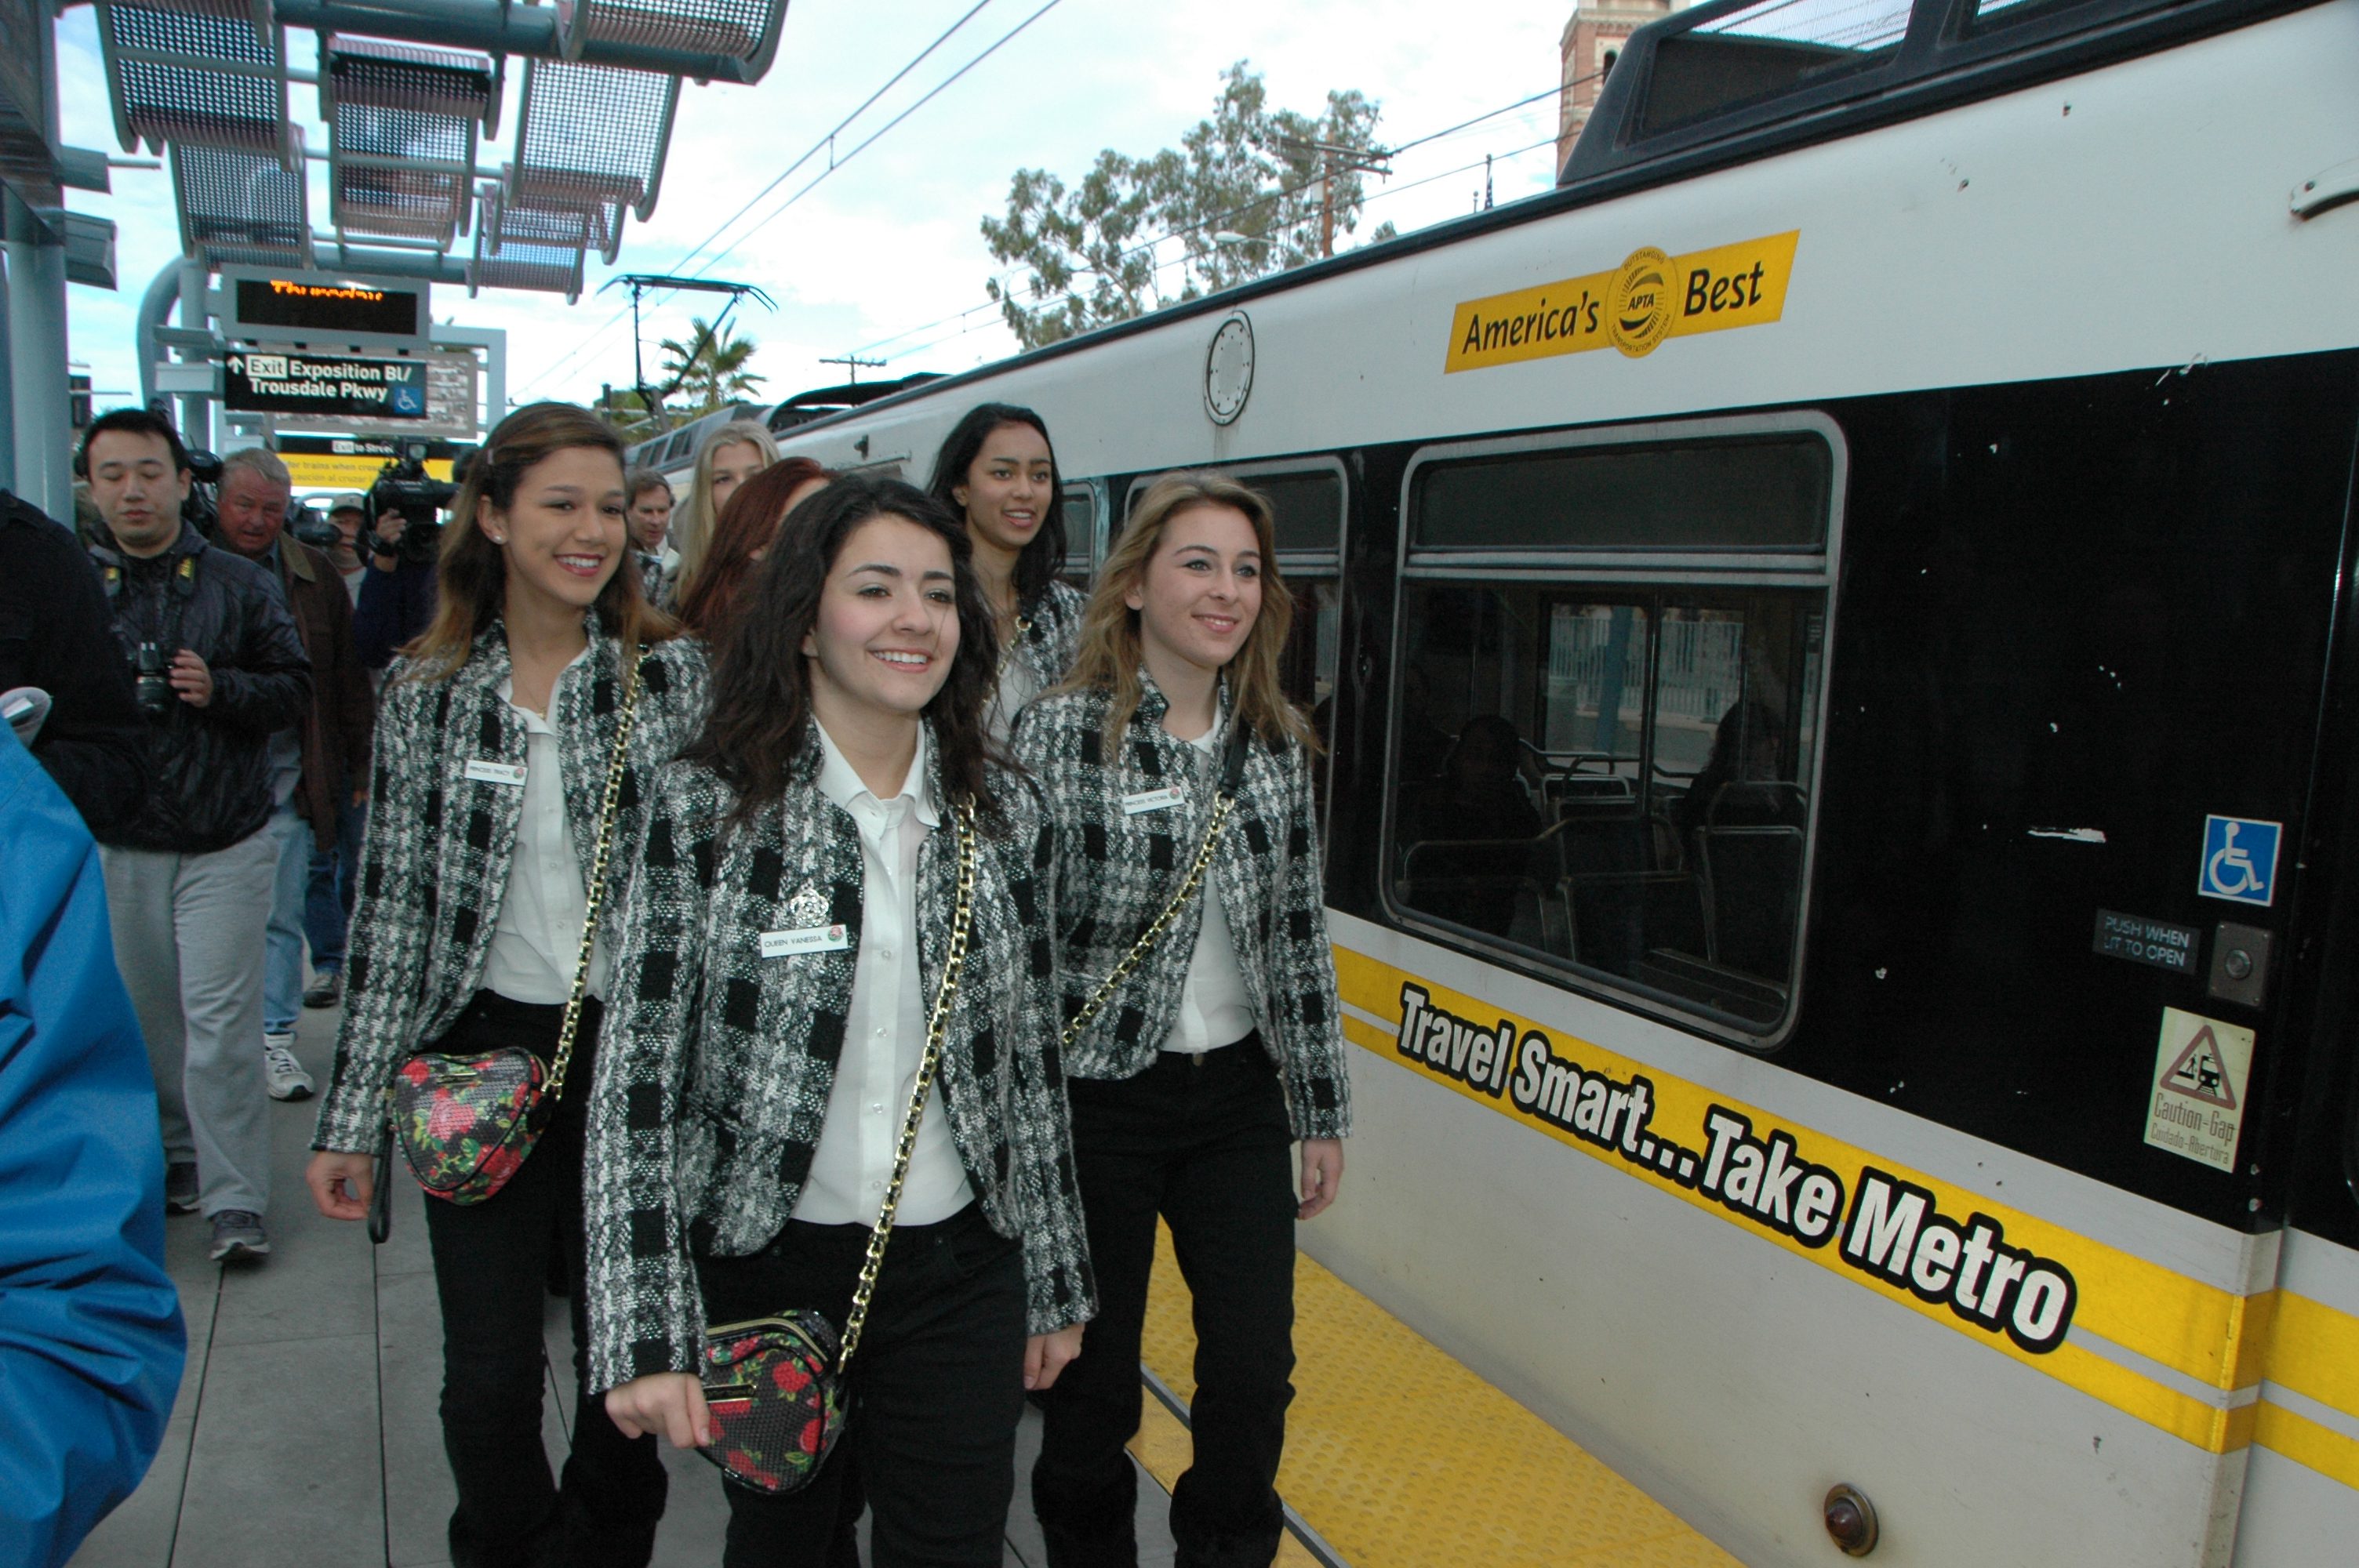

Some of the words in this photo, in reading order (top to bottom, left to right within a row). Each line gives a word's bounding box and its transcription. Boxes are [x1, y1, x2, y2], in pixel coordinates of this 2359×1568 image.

[1461, 290, 1600, 355] America's
[1683, 260, 1765, 318] Best
[1627, 292, 1655, 311] APTA
[1611, 323, 1652, 353] TRANSPORTATION
[1652, 314, 1670, 343] SYSTEM
[251, 358, 283, 374] Exit
[289, 360, 381, 382] Exposition
[249, 377, 337, 398] Trousdale
[340, 382, 388, 403] Pkwy
[335, 442, 353, 452] Exit
[354, 443, 365, 453] to
[303, 461, 330, 470] trains
[332, 463, 357, 471] when
[764, 939, 789, 949] QUEEN
[790, 935, 823, 945] VANESSA
[2104, 915, 2142, 937] PUSH
[2145, 925, 2190, 948] WHEN
[2125, 939, 2143, 956] TO
[2145, 945, 2186, 967] OPEN
[1398, 987, 1513, 1092] Travel
[1845, 1176, 2070, 1341] Metro
